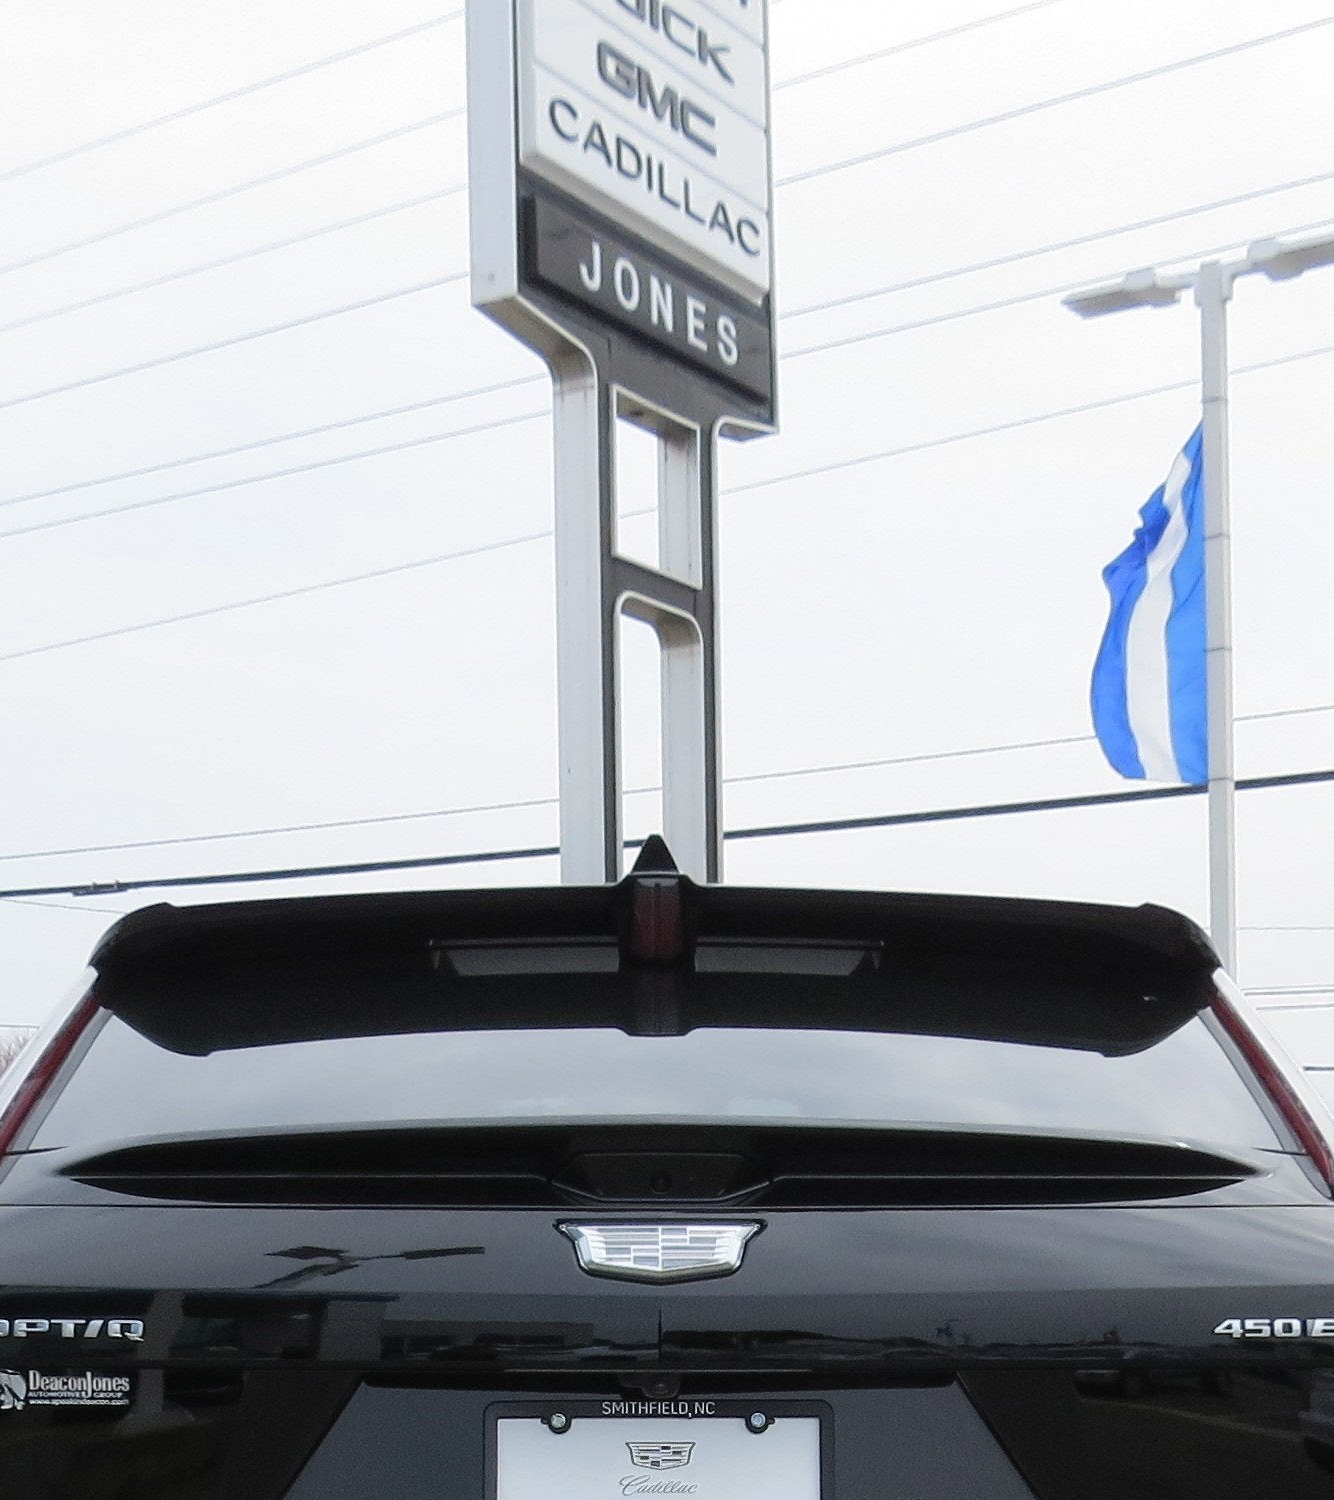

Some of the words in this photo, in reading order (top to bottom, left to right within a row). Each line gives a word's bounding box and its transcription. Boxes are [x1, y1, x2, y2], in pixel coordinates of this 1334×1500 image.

[597, 40, 717, 157] GMC
[549, 98, 761, 257] CADILLAC
[579, 240, 739, 366] JONES
[602, 1401, 693, 1418] SMITHFIELD,
[694, 1401, 715, 1415] NC
[619, 1475, 698, 1496] Cadillac
